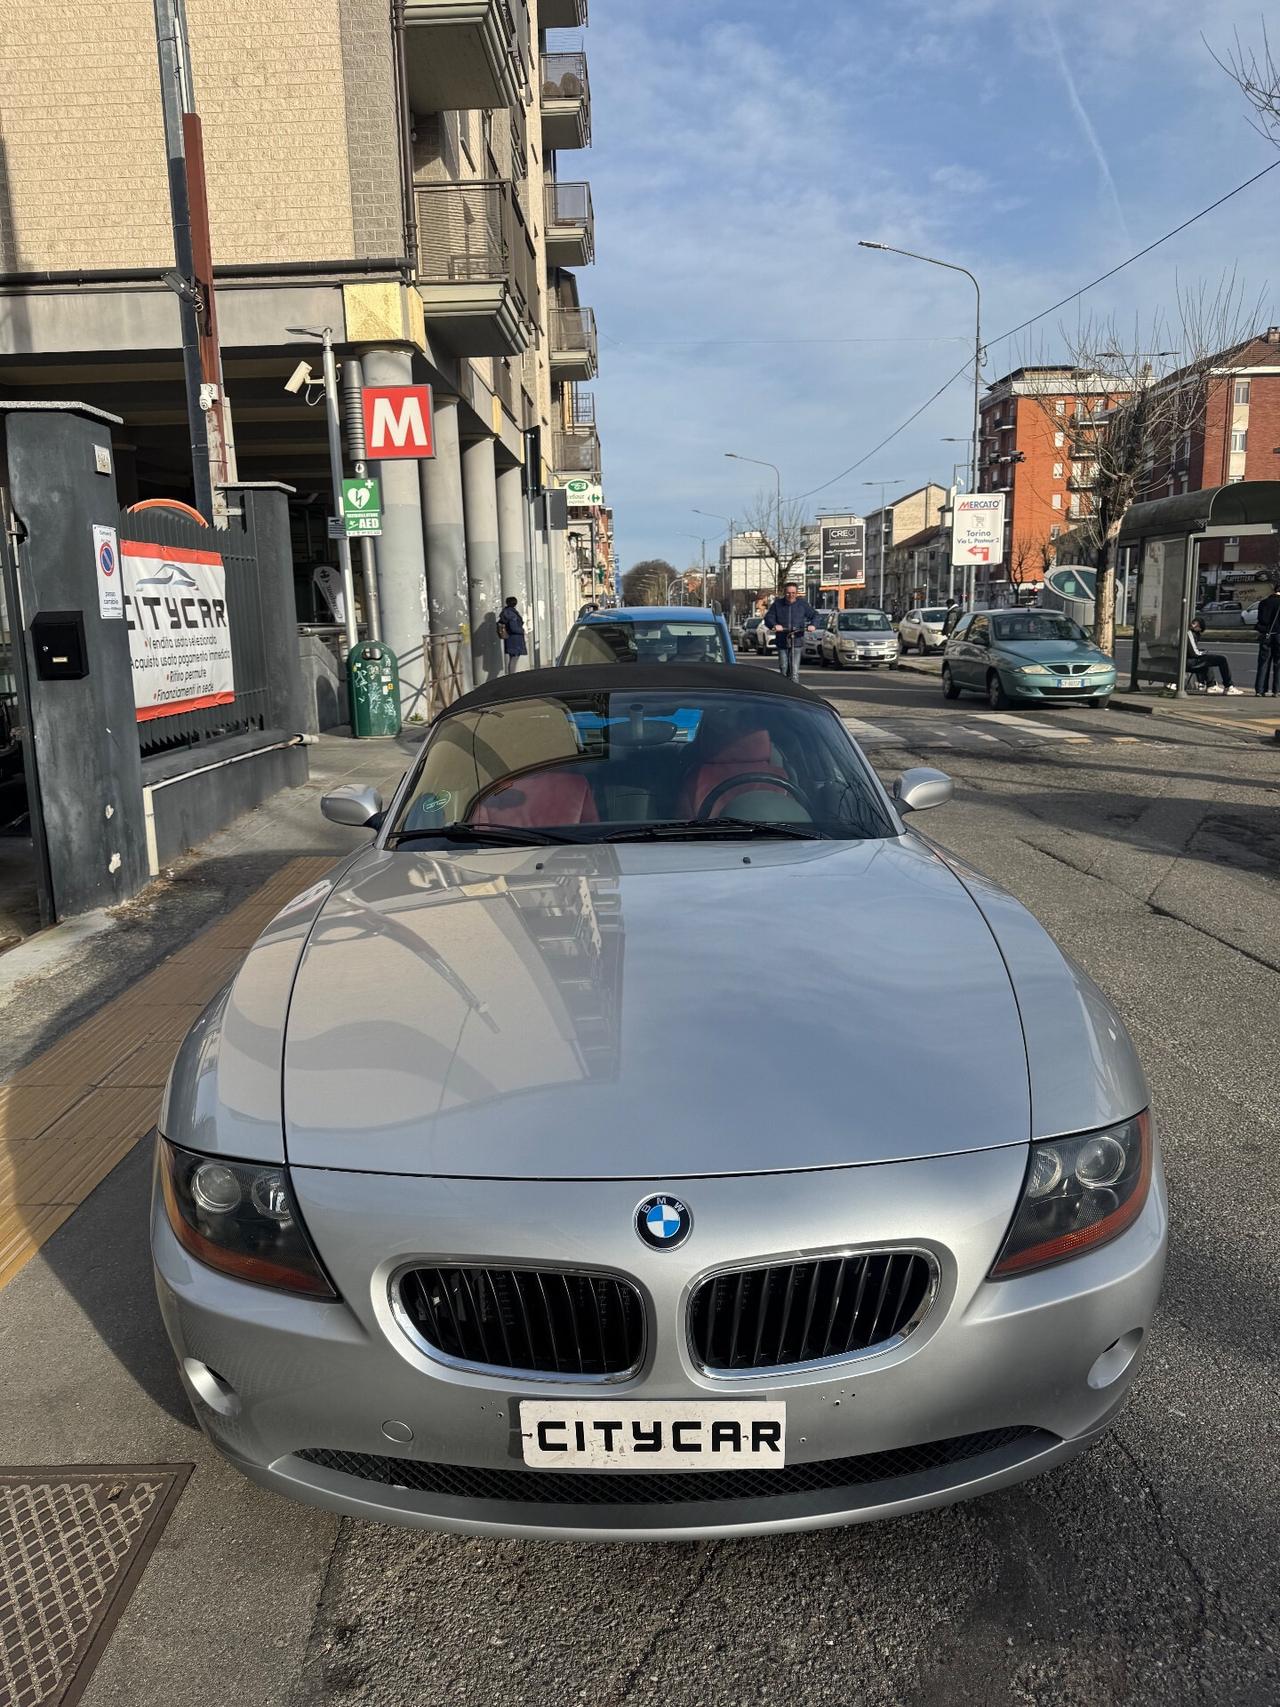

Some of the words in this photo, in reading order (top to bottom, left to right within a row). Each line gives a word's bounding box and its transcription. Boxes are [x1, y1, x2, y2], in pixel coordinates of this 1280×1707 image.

[371, 397, 428, 448] M
[359, 518, 379, 529] AED
[967, 529, 991, 537] Torino
[123, 595, 227, 630] CITYCAR
[147, 636, 174, 650] Vendita
[174, 635, 188, 648] usato
[189, 635, 217, 648] selezionato
[160, 653, 177, 667] usato
[178, 651, 208, 669] pagamento
[209, 648, 231, 661] immediato
[170, 670, 184, 682] Ritiro
[185, 668, 207, 683] permute
[156, 685, 196, 702] Finanziamenti
[196, 683, 201, 694] in
[202, 681, 215, 693] sede
[641, 1197, 685, 1214] BMW
[537, 1421, 781, 1453] CITYCAR
